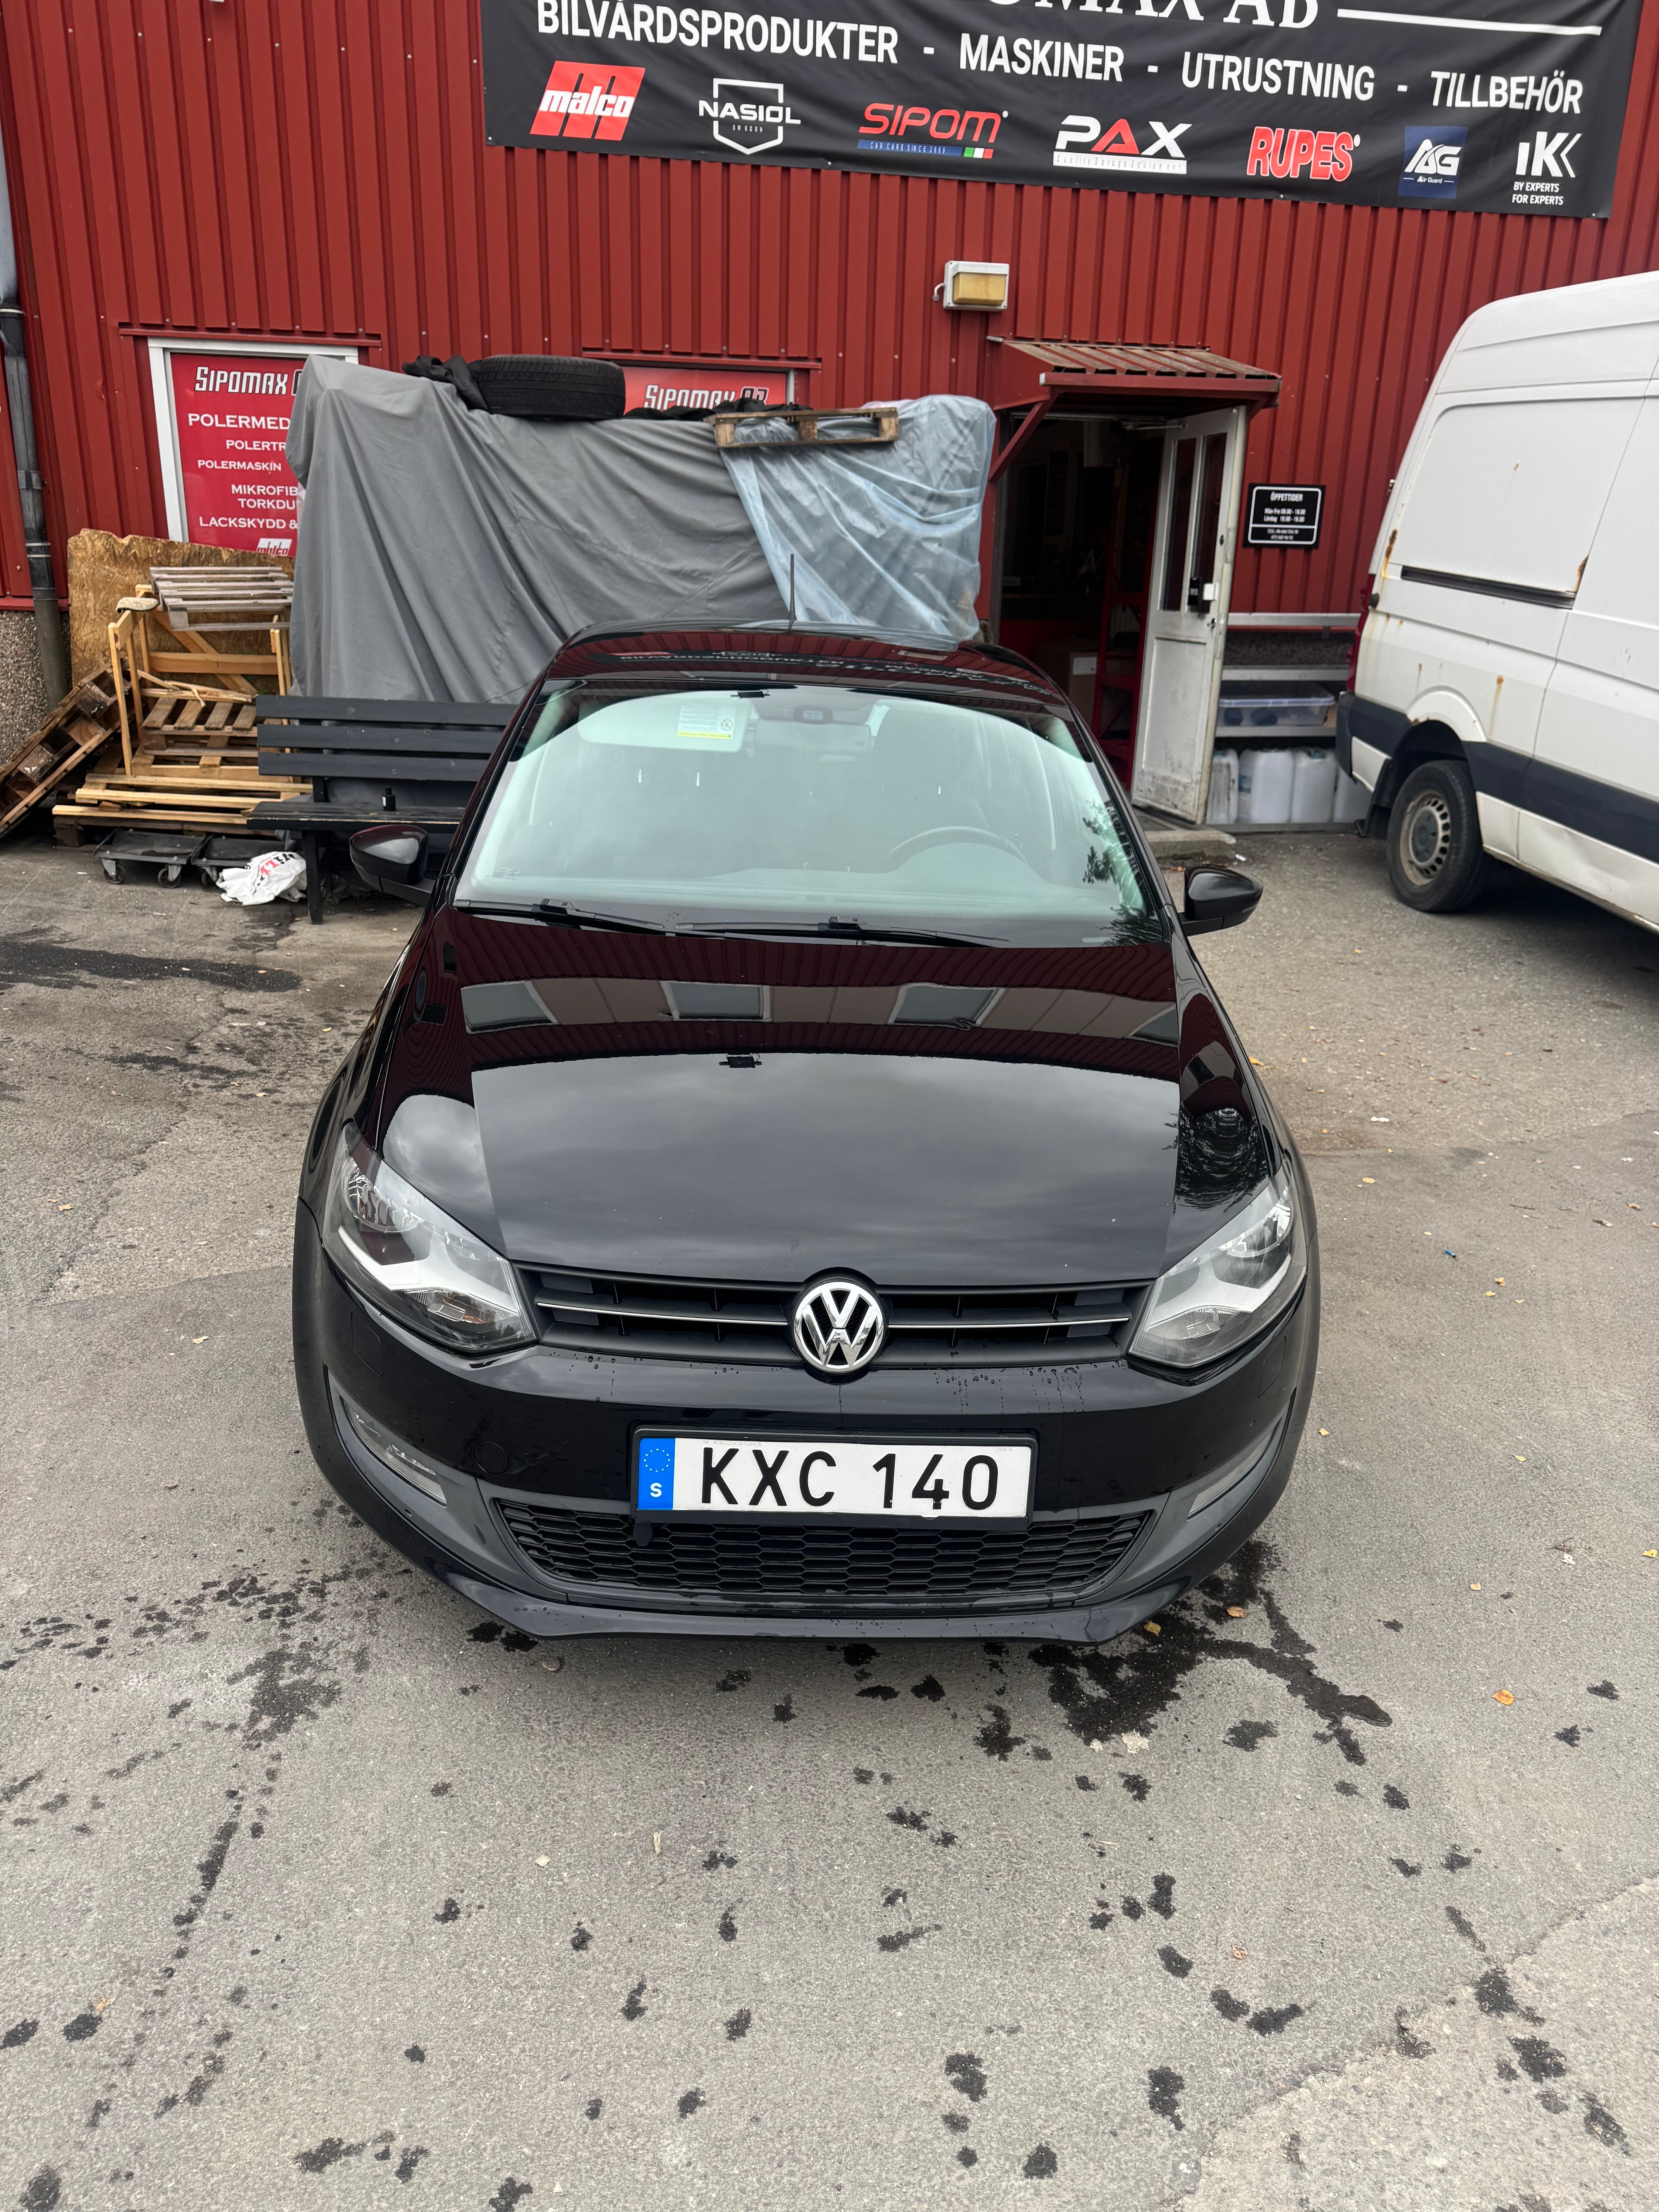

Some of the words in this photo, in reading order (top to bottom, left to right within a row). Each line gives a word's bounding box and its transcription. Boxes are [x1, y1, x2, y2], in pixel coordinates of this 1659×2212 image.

[960, 33, 1124, 81] MASKINER
[1182, 52, 1375, 101] UTRUSTNING
[1431, 69, 1583, 113] TILLBEHÖR
[539, 86, 635, 117] malco
[699, 100, 801, 124] NASIOL
[859, 103, 1001, 143] SIPOM
[1055, 115, 1192, 158] PAX
[1512, 194, 1528, 204] FOR
[1530, 195, 1564, 205] EXPERTS
[1513, 182, 1524, 191] BY
[1525, 182, 1559, 192] EXPERTS
[194, 366, 288, 395] SIPOMAX
[198, 460, 282, 471] POLERMASKIN
[199, 516, 286, 529] LACKSKYDD
[649, 1482, 662, 1498] S
[701, 1447, 837, 1507] KXC
[872, 1453, 998, 1510] 140
